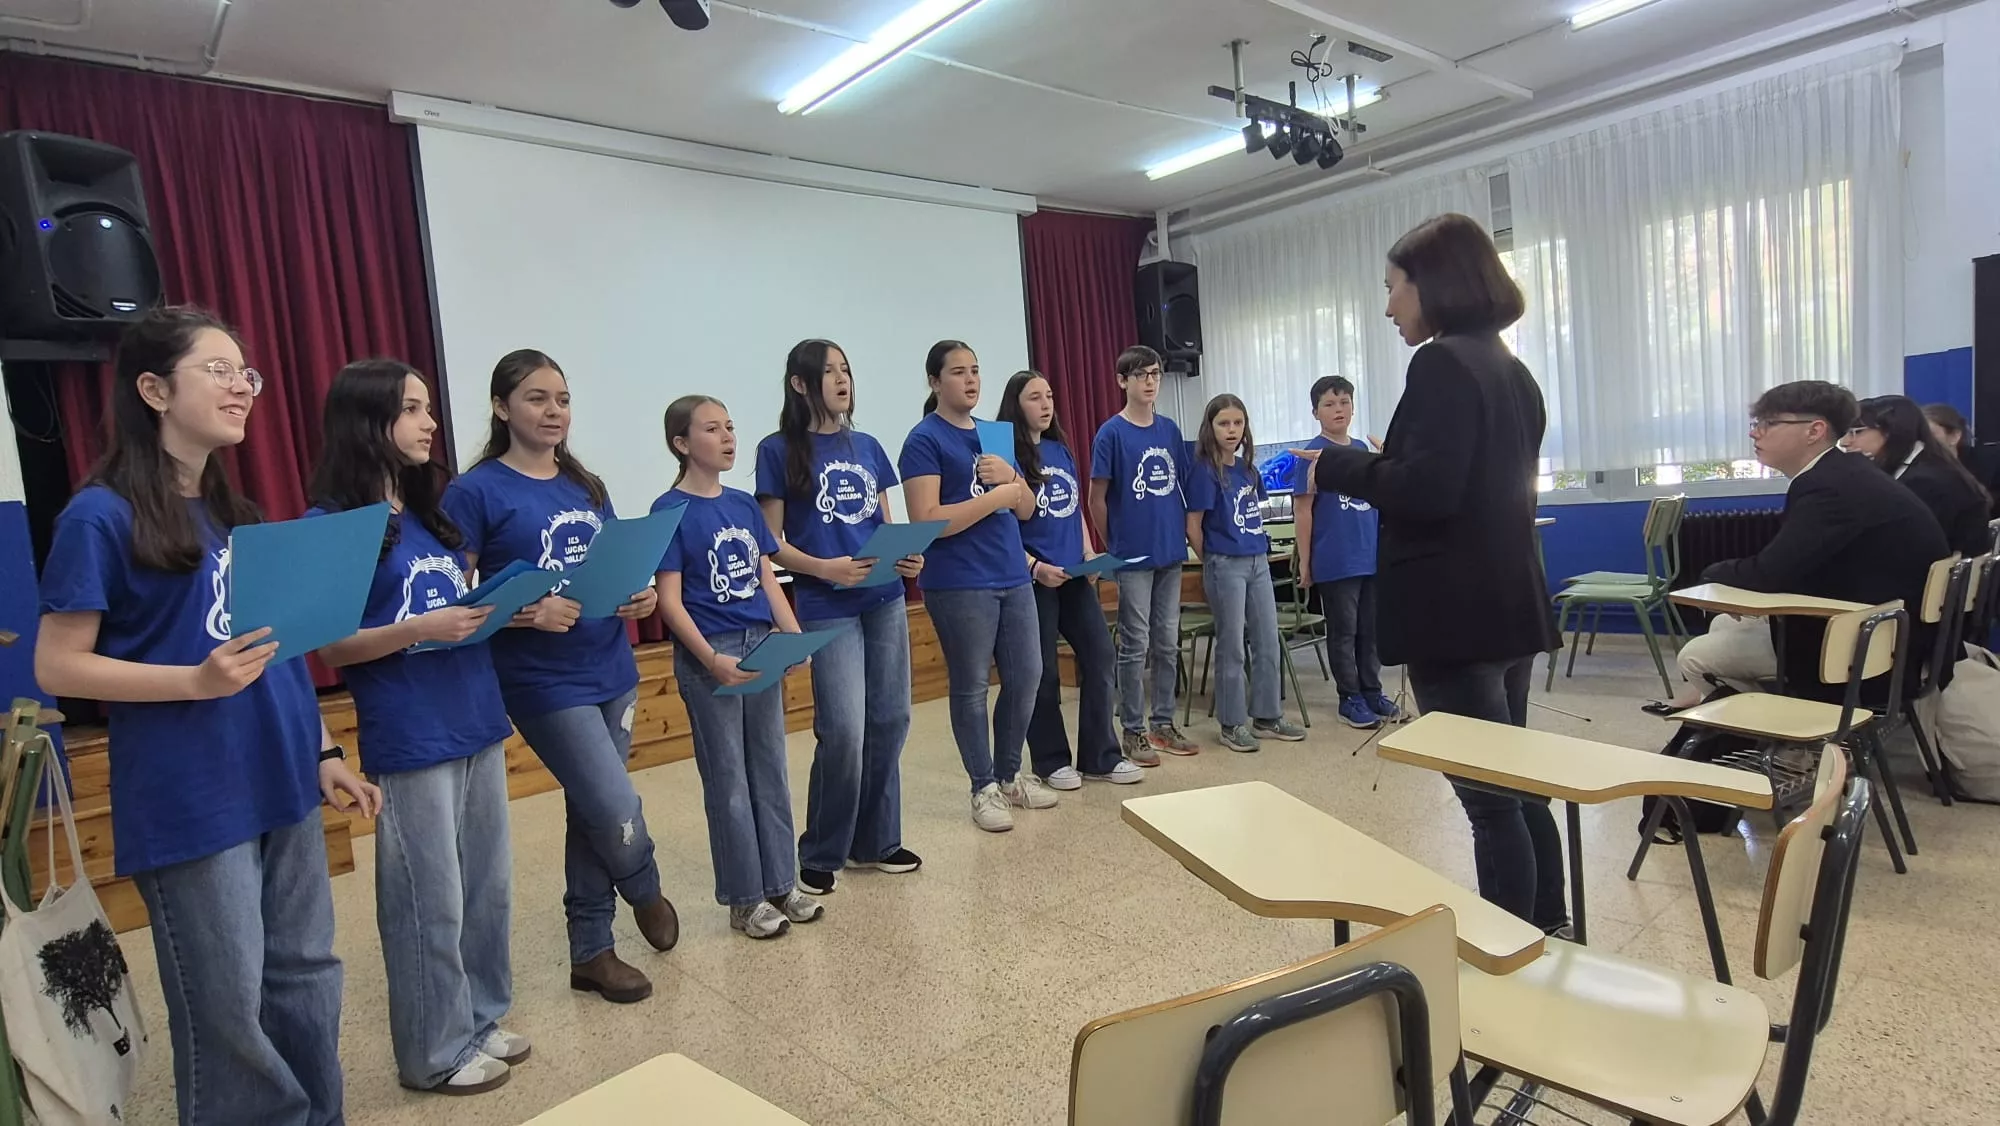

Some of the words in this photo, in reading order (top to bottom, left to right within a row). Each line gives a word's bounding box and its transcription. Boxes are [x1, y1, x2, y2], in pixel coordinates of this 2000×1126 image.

[568, 536, 580, 545] IES
[565, 544, 587, 555] LUCAS
[728, 554, 738, 562] IES
[426, 588, 438, 598] IES
[426, 597, 447, 609] LUCAS
